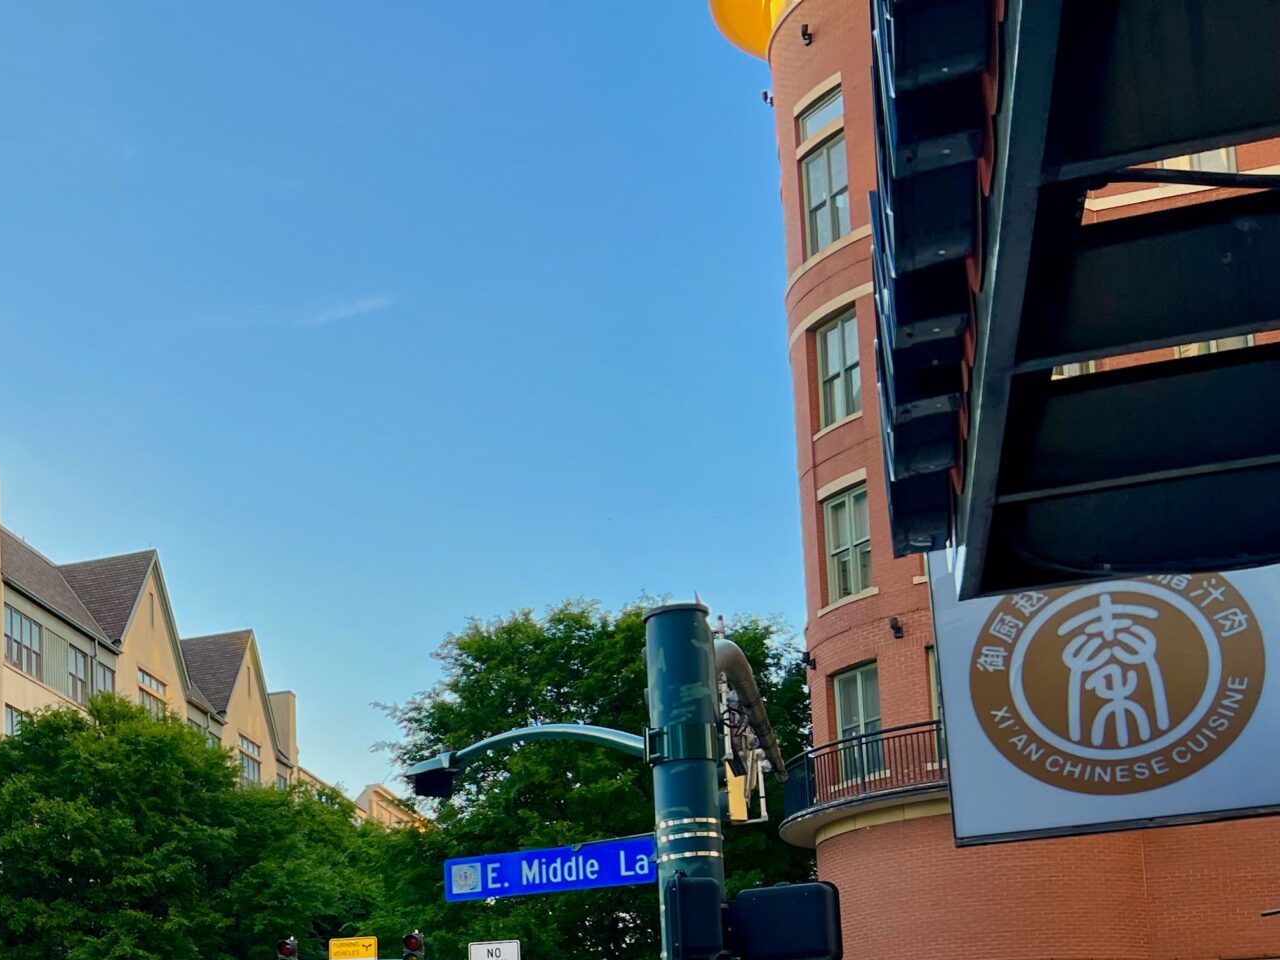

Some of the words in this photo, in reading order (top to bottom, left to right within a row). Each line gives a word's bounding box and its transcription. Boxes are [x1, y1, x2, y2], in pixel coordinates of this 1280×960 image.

[990, 706, 1045, 762] XI'AN
[1045, 755, 1170, 783] CHINESE
[1172, 675, 1249, 764] CUISINE
[487, 862, 510, 889] E.
[521, 855, 600, 886] Middle
[619, 850, 650, 877] La
[486, 947, 501, 958] NO
